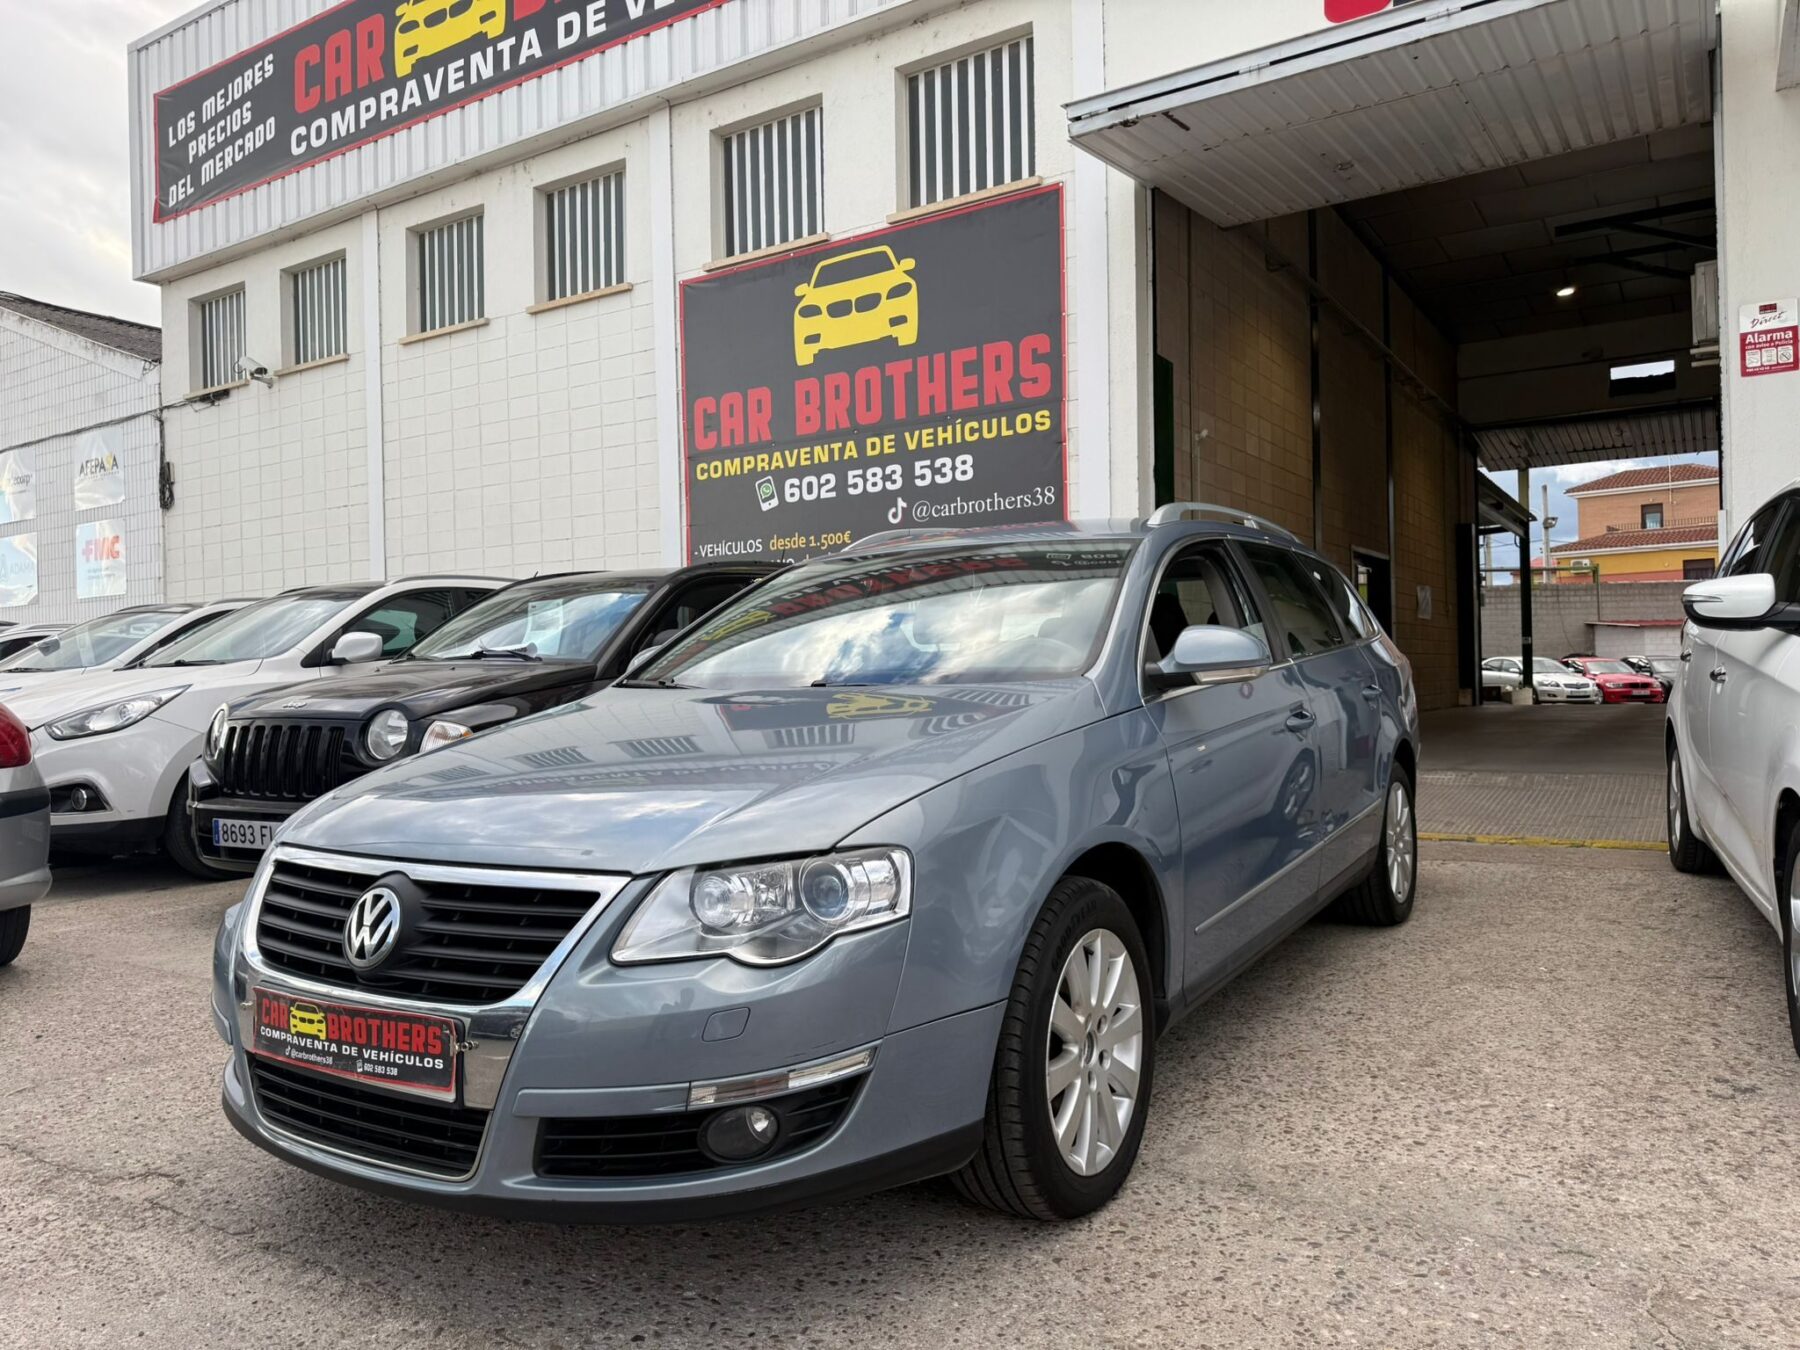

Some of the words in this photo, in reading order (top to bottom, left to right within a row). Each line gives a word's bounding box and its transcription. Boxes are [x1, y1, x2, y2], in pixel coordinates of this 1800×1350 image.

[290, 28, 543, 156] COMPRAVENTA
[557, 2, 607, 49] DE
[294, 13, 385, 114] CAR
[169, 110, 195, 148] LOS
[202, 53, 274, 124] MEJORES
[168, 174, 194, 208] DEL
[201, 116, 275, 186] MERCADO
[188, 101, 252, 164] PRECIOS
[1745, 331, 1792, 344] Alarma
[694, 386, 772, 450] CAR
[794, 333, 1052, 437] BROTHERS
[695, 440, 858, 481] COMPRAVENTA
[865, 434, 896, 457] DE
[904, 409, 1051, 451] VEHÍCULOS
[783, 473, 836, 502] 602
[847, 464, 902, 495] 583
[914, 454, 974, 487] 538
[911, 486, 1056, 523] @carbrothers38
[769, 532, 807, 551] desde
[809, 530, 852, 550] 1.500€
[221, 823, 256, 845] 8693
[260, 1026, 338, 1053] COMPRAVENTA
[342, 1045, 359, 1057] DE
[362, 1048, 444, 1070] VEHÍCULOS
[262, 998, 289, 1030] CAR
[327, 1012, 442, 1055] BROTHERS
